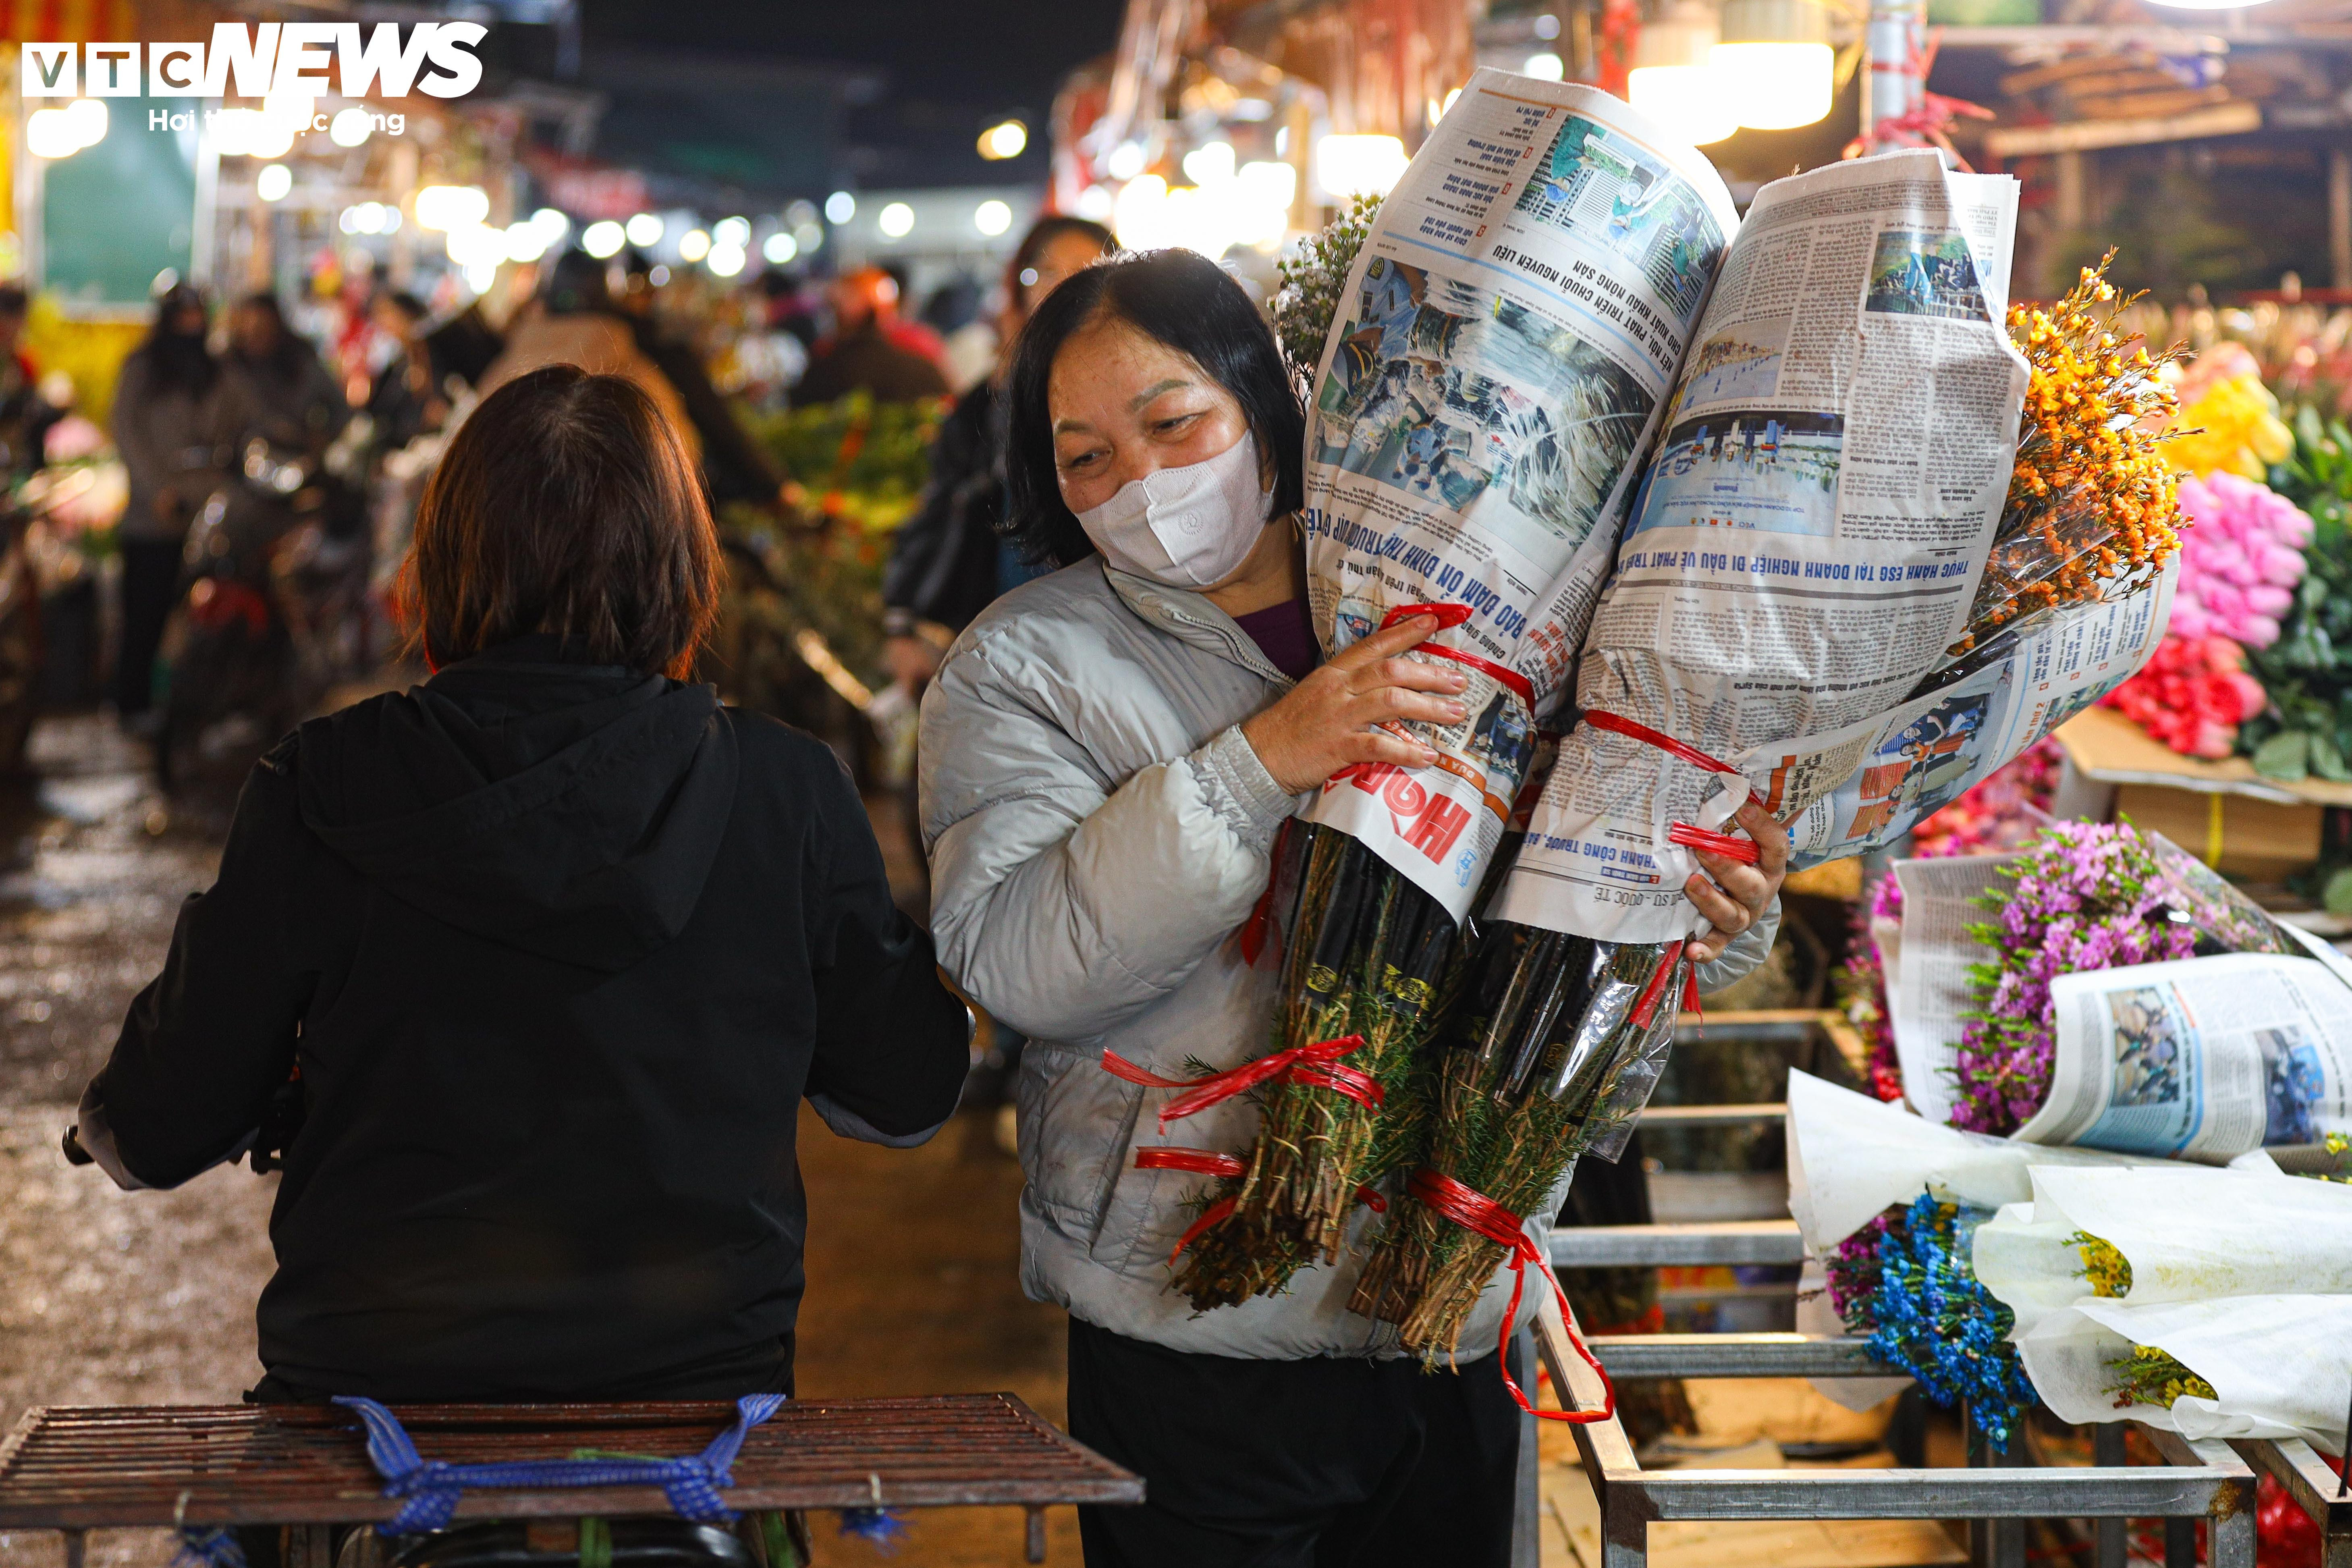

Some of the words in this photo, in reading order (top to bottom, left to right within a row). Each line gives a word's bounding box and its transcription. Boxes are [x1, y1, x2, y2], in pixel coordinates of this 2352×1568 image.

[1492, 245, 1517, 262] LIỆU
[1516, 254, 1559, 282] NGUYÊN
[1573, 260, 1596, 280] SẢN
[1559, 276, 1594, 301] CHUỖI
[1596, 274, 1626, 299] NÔNG
[1594, 296, 1624, 322] TRIỂN
[1626, 294, 1652, 321] KHẨU
[1623, 317, 1648, 342] PHÁT
[1650, 314, 1669, 341] XUẤT
[1667, 334, 1681, 356] CHO
[1660, 353, 1674, 373] KẾT
[1400, 545, 1440, 579] ĐỊNH
[1650, 552, 1678, 568] PHÁT
[1680, 551, 1695, 573] VỀ
[1701, 552, 1727, 575] ĐẦU
[1732, 555, 1745, 571] ĐI
[1751, 557, 1799, 576] NGHIỆP
[1941, 561, 1968, 578] THỰC
[1805, 562, 1850, 580] DOANH
[1855, 562, 1874, 580] TẠI
[1880, 566, 1903, 582] ESG
[1906, 565, 1939, 582] HÀNH
[1385, 575, 1404, 592] trên
[1435, 563, 1464, 600] ỔN
[1461, 619, 1480, 639] gian
[1494, 604, 1527, 640] BẢO
[1478, 635, 1506, 659] Chống
[1449, 760, 1475, 779] ĐƯA
[1584, 843, 1616, 862] CÔNG
[1594, 887, 1611, 901] TẾ
[1614, 891, 1644, 908] QUỐC
